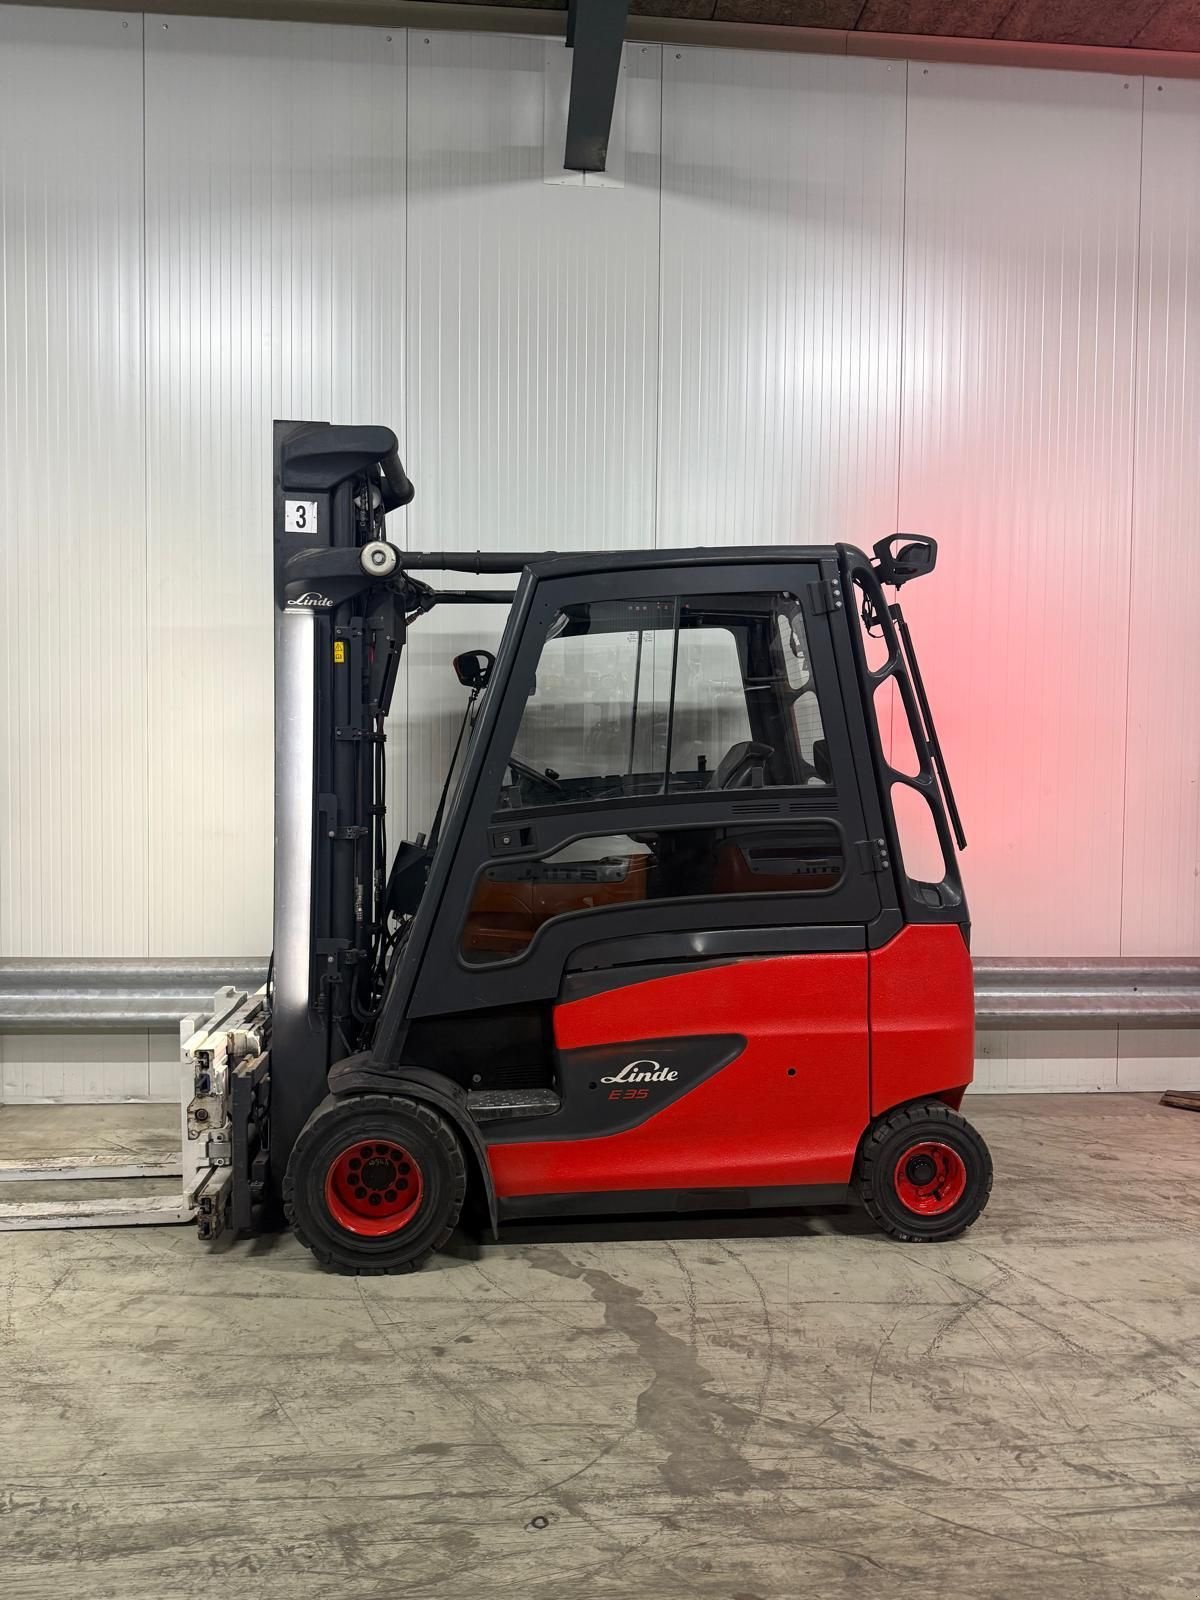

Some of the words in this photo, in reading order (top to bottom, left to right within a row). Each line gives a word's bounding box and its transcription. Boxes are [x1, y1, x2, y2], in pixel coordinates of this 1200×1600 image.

[296, 505, 306, 528] 3
[288, 592, 334, 606] Linde
[600, 1060, 678, 1083] Linde
